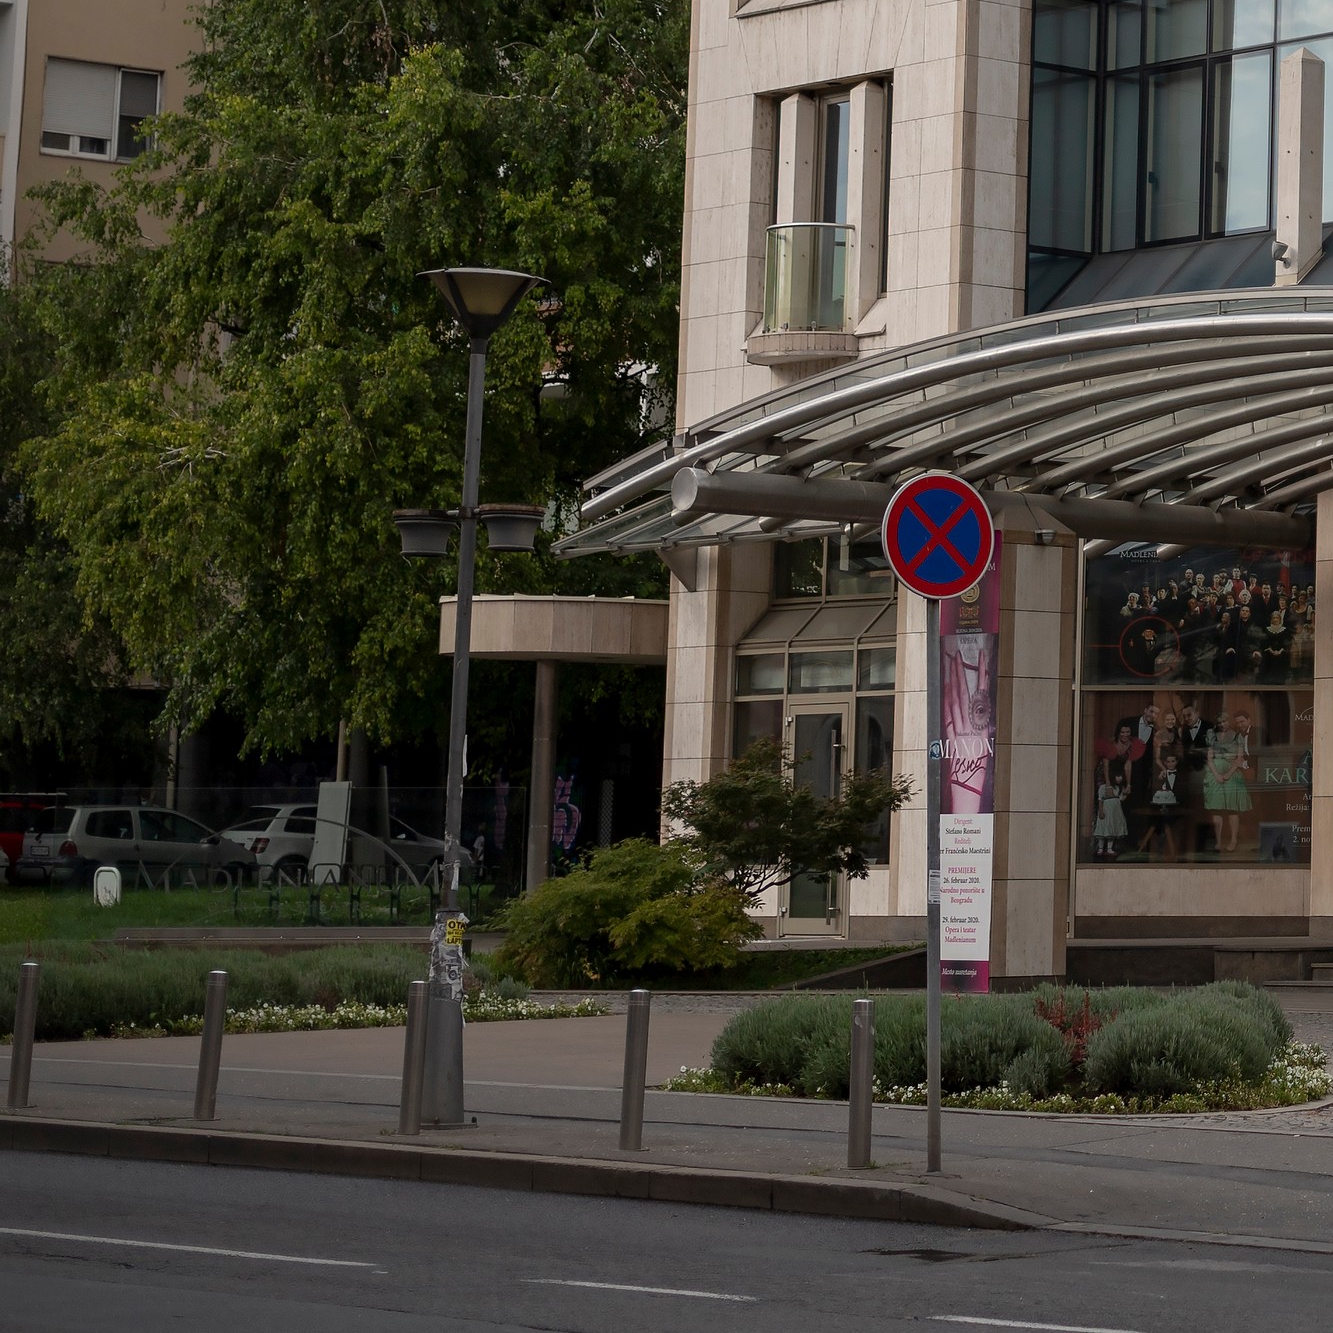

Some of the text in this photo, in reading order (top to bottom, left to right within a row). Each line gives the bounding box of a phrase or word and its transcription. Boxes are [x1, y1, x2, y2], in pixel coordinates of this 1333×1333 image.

[939, 738, 995, 759] MANON
[1286, 803, 1310, 812] Režija:
[945, 827, 981, 835] Stefano Romani
[948, 866, 976, 874] PREMIJERE
[950, 896, 973, 904] Beogradu
[945, 927, 960, 935] Opera
